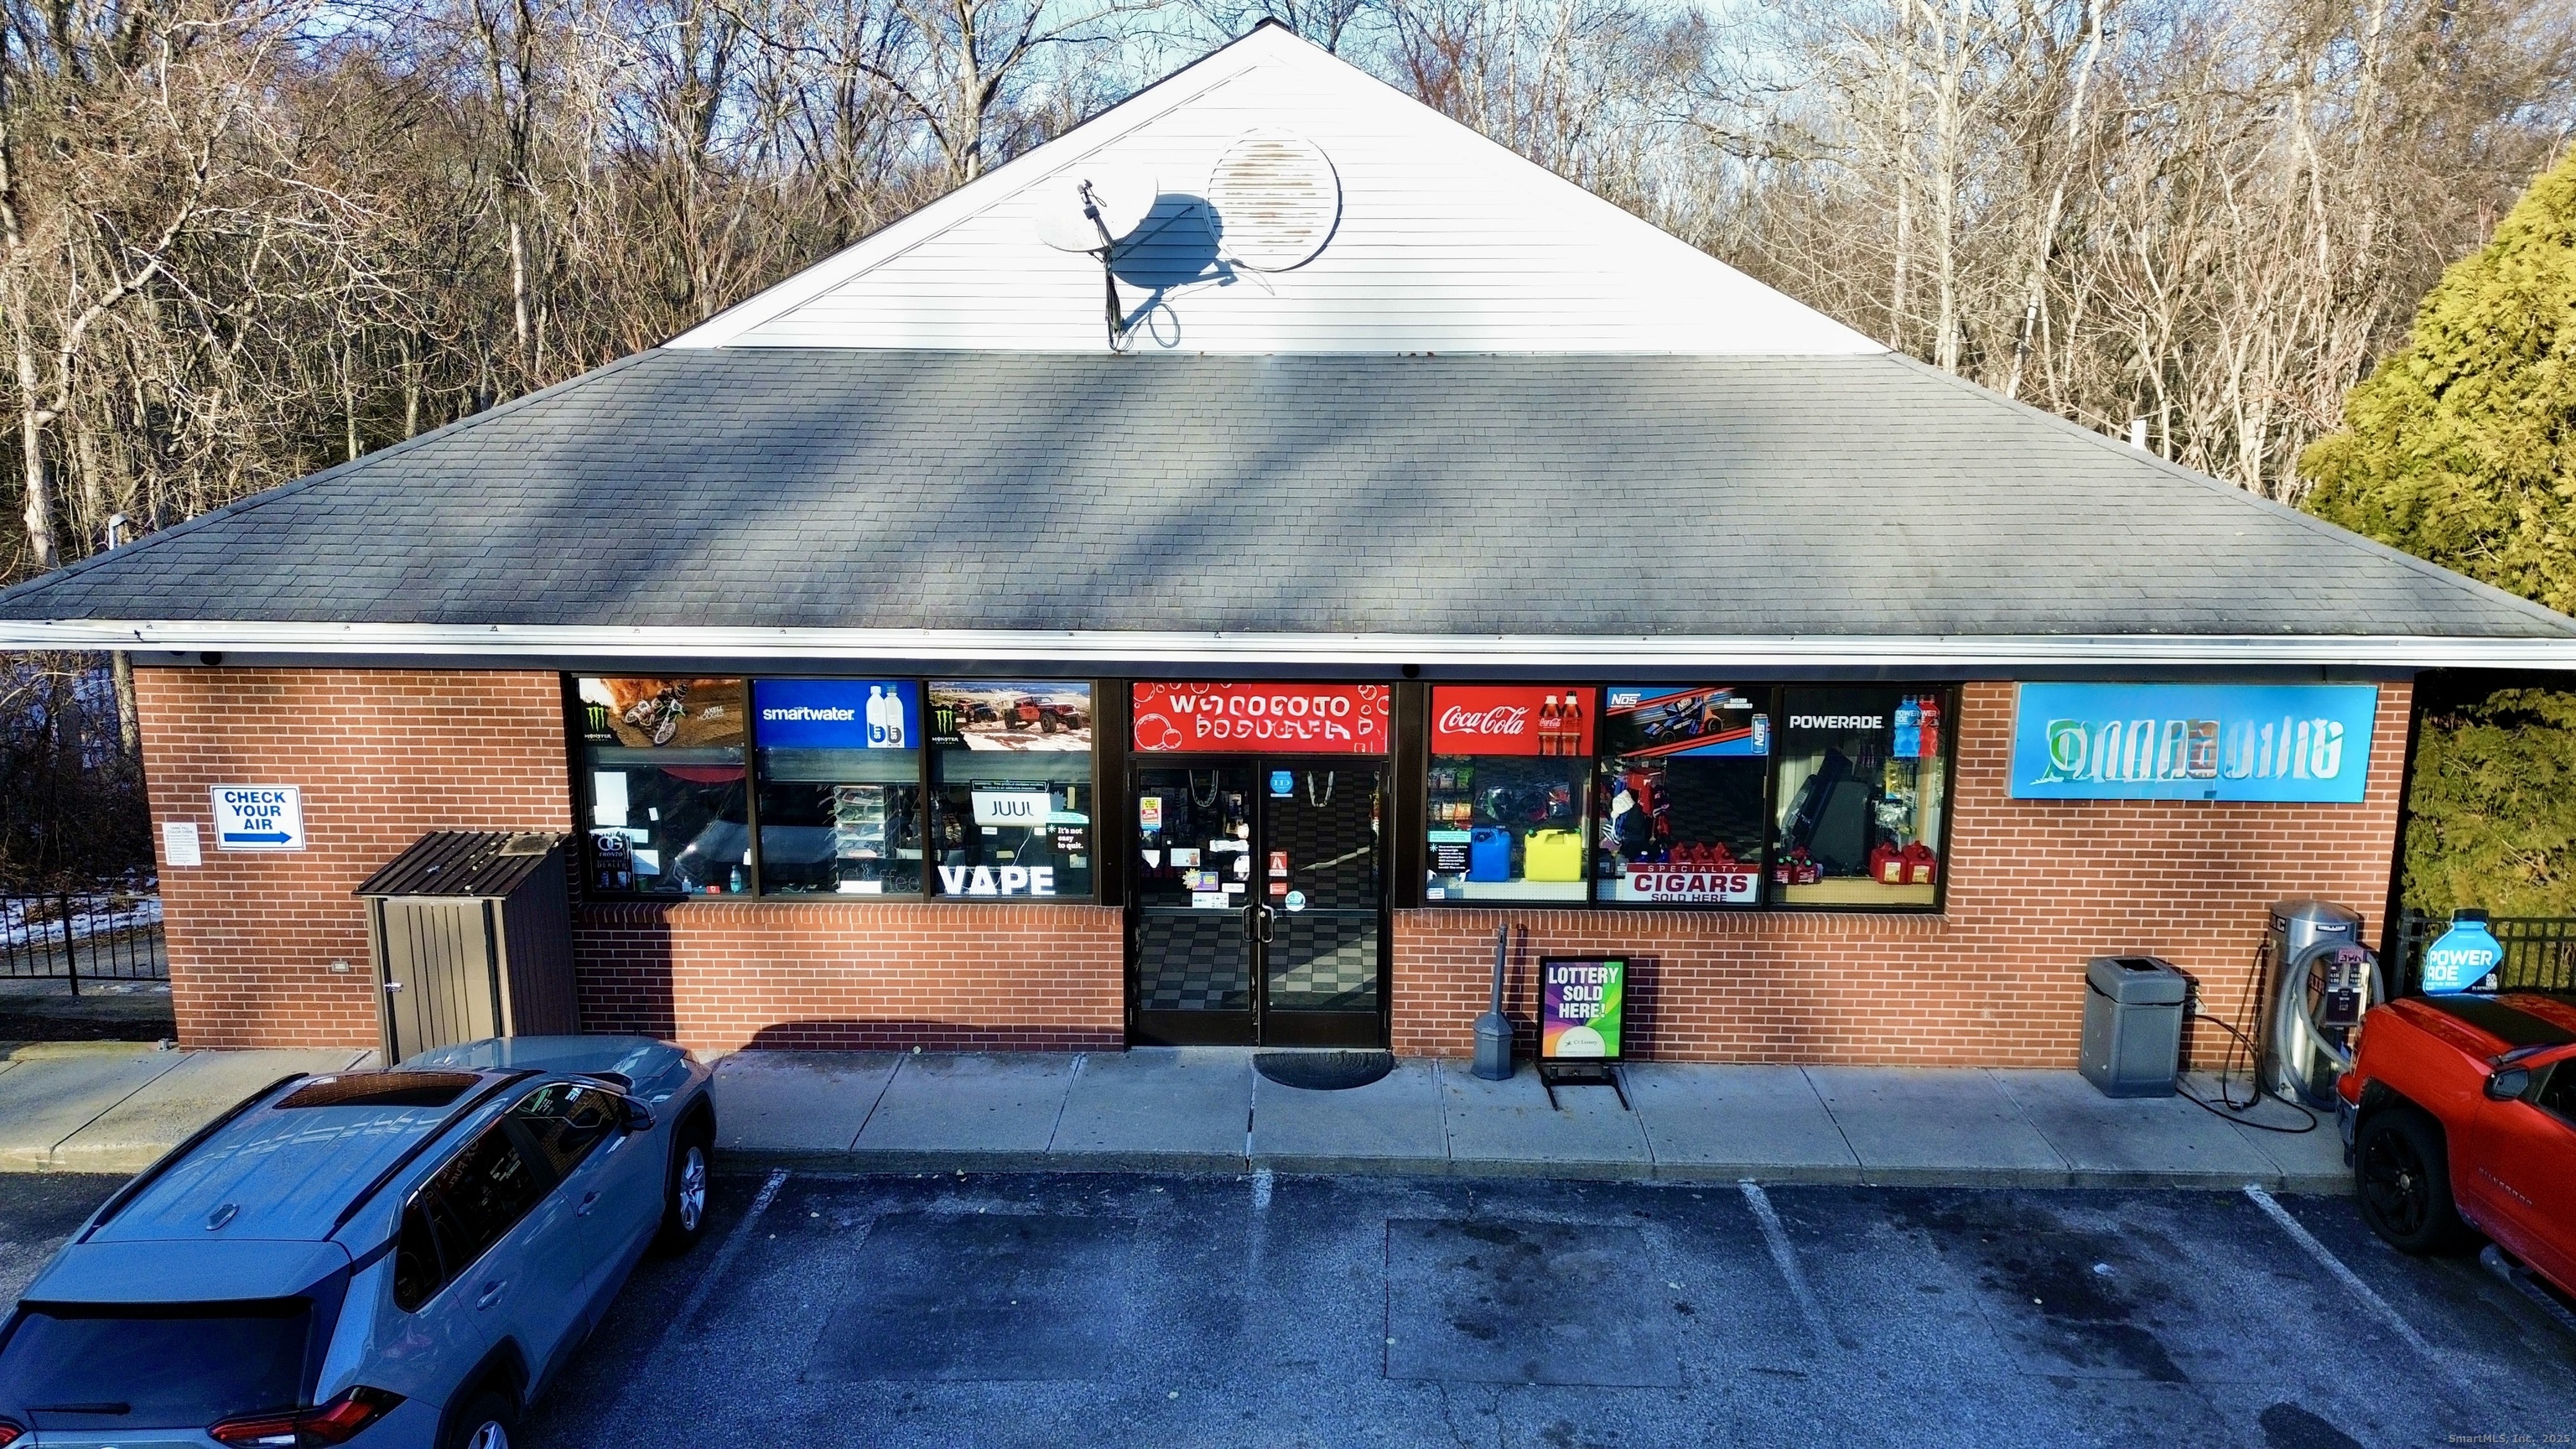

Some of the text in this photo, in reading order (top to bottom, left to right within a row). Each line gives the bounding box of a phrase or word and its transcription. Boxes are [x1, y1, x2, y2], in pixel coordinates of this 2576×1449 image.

[1611, 693, 1641, 704] NOS
[704, 705, 724, 715] AXELL
[1438, 705, 1530, 735] Coca-Cola
[1789, 715, 1883, 729] POWERADE
[224, 791, 287, 803] CHECK
[231, 805, 282, 817] YOUR
[991, 800, 1035, 817] JUUL
[243, 818, 273, 830] AIR
[597, 835, 623, 851] OG
[1057, 834, 1074, 843] easy
[1648, 865, 1738, 873] SPECIALTY
[937, 865, 1056, 896] VAPE
[1633, 874, 1748, 893] CIGARS
[1651, 893, 1727, 902] SOLD HERE
[2429, 949, 2493, 966] POWER
[1548, 967, 1619, 984] LOTTERY
[2427, 965, 2459, 981] ADE
[1562, 985, 1603, 1001] SOLD
[1558, 1003, 1606, 1018] HERE!
